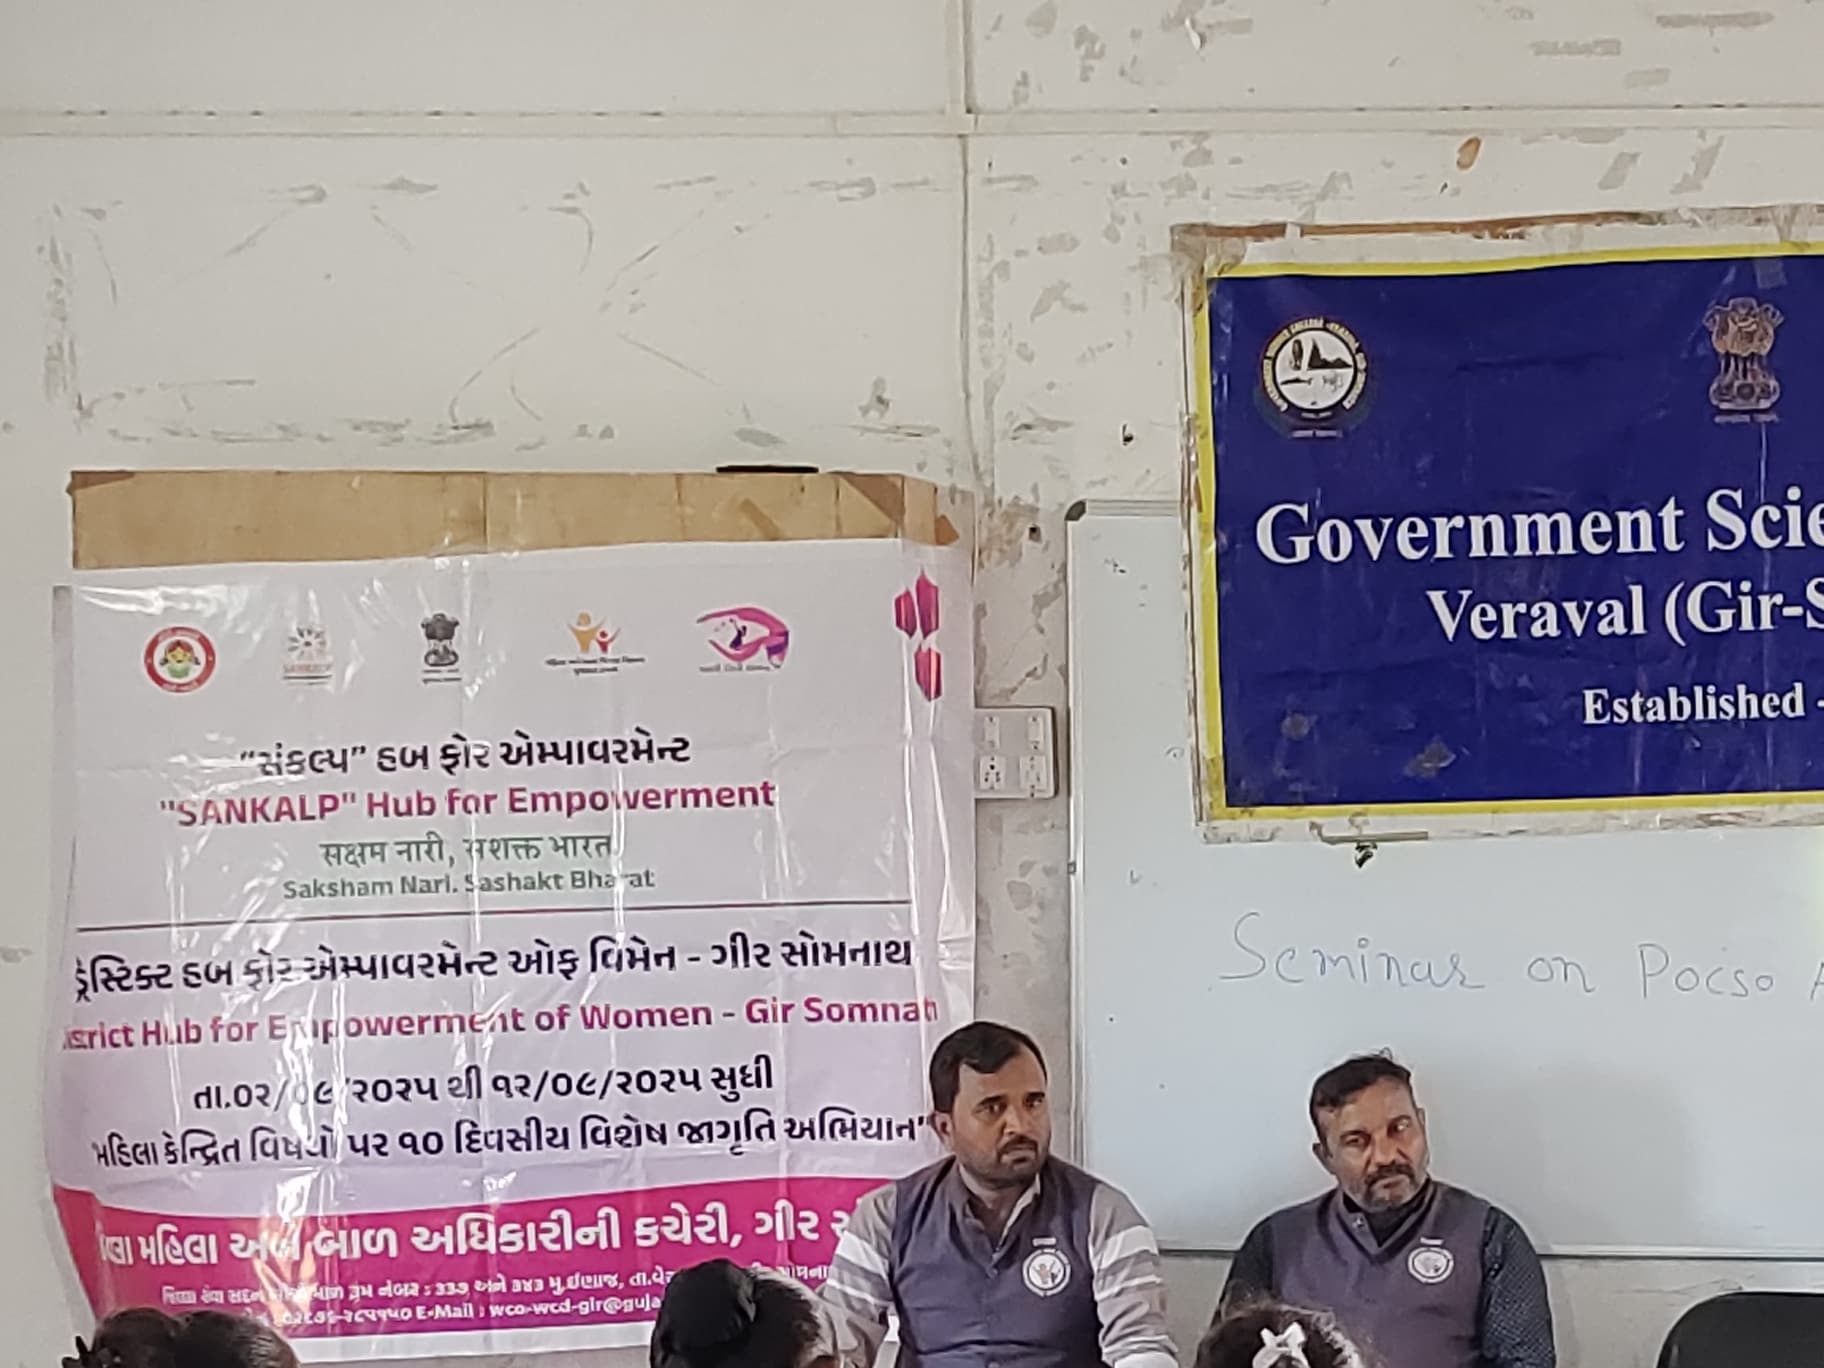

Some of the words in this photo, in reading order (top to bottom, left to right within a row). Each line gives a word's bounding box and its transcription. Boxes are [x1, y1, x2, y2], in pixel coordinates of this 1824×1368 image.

[1255, 496, 1686, 565] Government
[1425, 584, 1647, 642] Veraval
[1582, 682, 1806, 725] Established
[377, 745, 429, 772] હબ
[500, 726, 691, 767] એમ્પાવરમેન્ટ
[160, 792, 356, 827] "SANKALP"
[367, 790, 436, 818] Hub
[446, 788, 498, 817] for
[508, 780, 775, 818] Empowerment
[320, 841, 388, 868] सक्षम
[394, 830, 455, 867] नारी,
[463, 836, 543, 862] सशक्त
[550, 834, 612, 860] भारत
[284, 878, 393, 900] Saksham
[465, 871, 564, 892] Sashakt
[182, 960, 233, 988] હબ
[590, 935, 677, 973] વિમેન
[711, 931, 772, 969] ગીર
[781, 929, 912, 968] સોમનાથ
[1219, 911, 1486, 990] Seminar
[1527, 955, 1597, 993] on
[142, 1017, 203, 1047] Hub
[210, 1015, 259, 1044] for
[535, 1003, 573, 1031] of
[580, 1002, 713, 1031] Women
[745, 996, 796, 1024] Gir
[710, 1054, 773, 1102] સુધી
[348, 1131, 389, 1158] પર
[455, 1115, 570, 1154] દિવસીય
[580, 1112, 668, 1150] વિશેષ
[141, 1223, 218, 1265] મહિલા
[314, 1227, 399, 1260] બાળ
[410, 1206, 621, 1256] અધિકારીની
[634, 1201, 743, 1249] કચેરી,
[754, 1198, 820, 1242] ગીર
